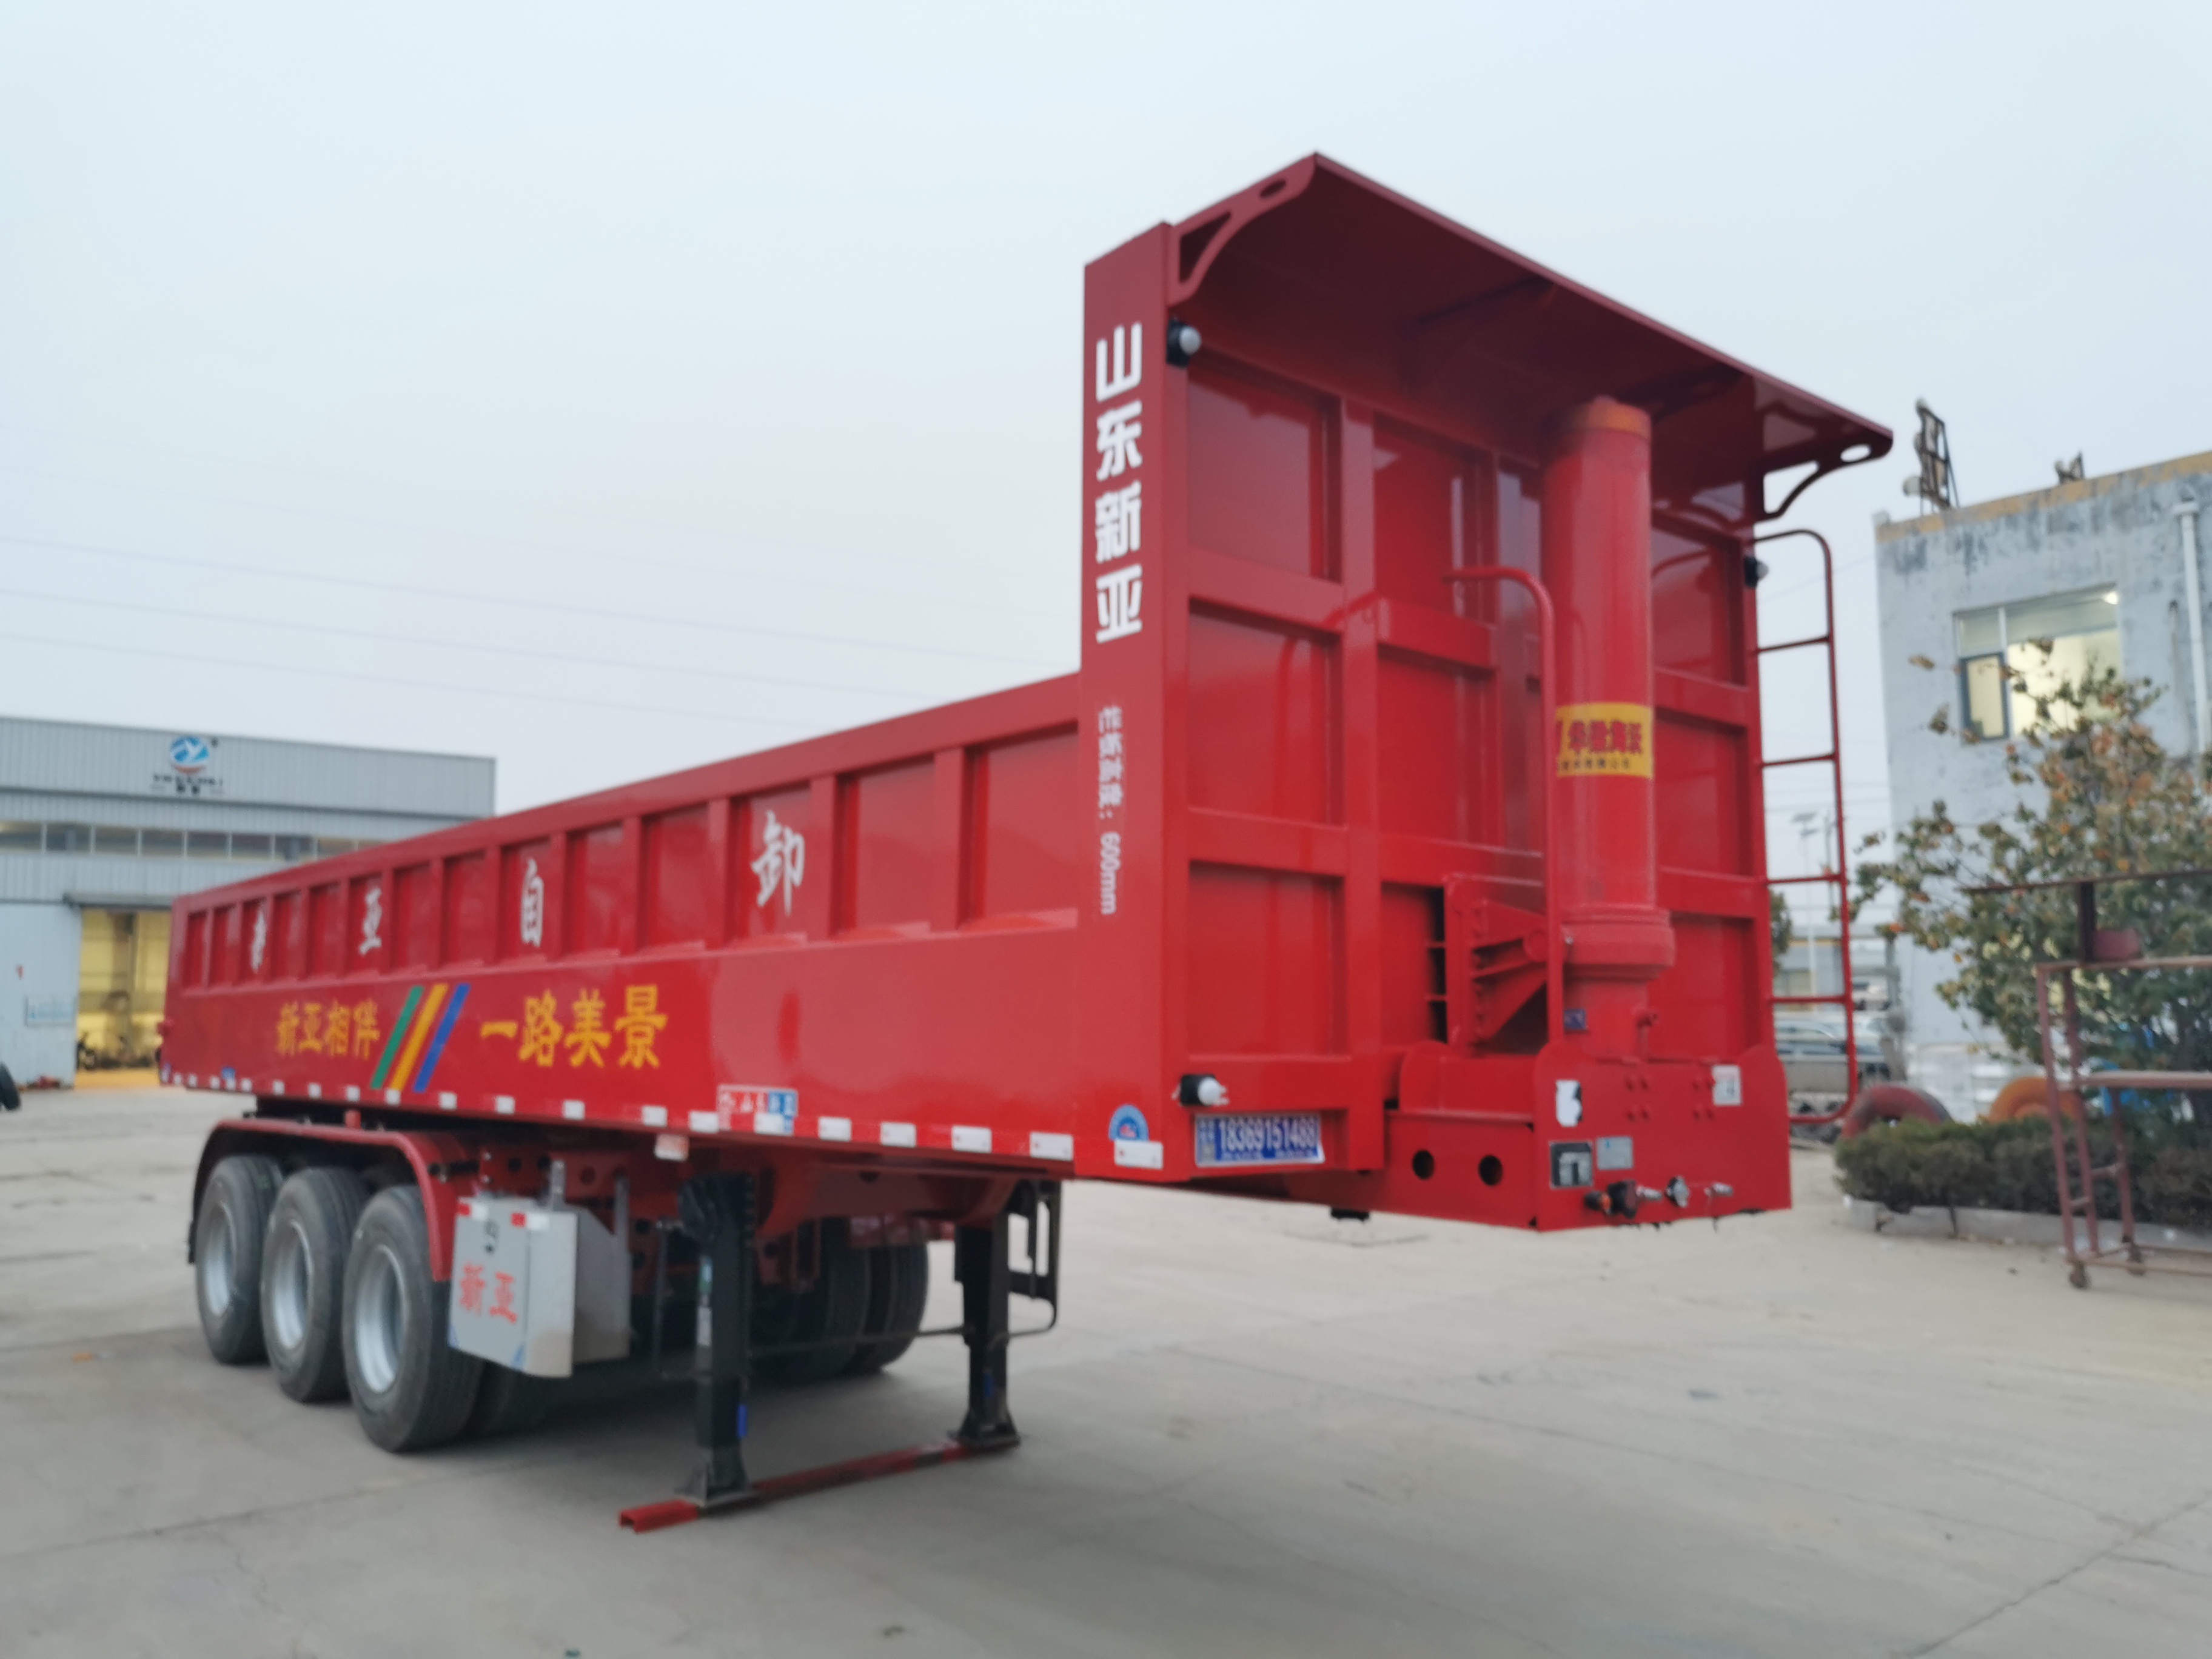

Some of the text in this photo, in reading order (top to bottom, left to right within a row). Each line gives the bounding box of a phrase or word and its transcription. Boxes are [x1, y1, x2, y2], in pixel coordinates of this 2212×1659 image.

[1095, 321, 1143, 644] 山东新亚
[520, 857, 544, 948] 自
[751, 810, 805, 916] 卸
[1099, 831, 1121, 916] 600mm
[480, 984, 669, 1069] 一路美景
[460, 1261, 518, 1324] 新亚
